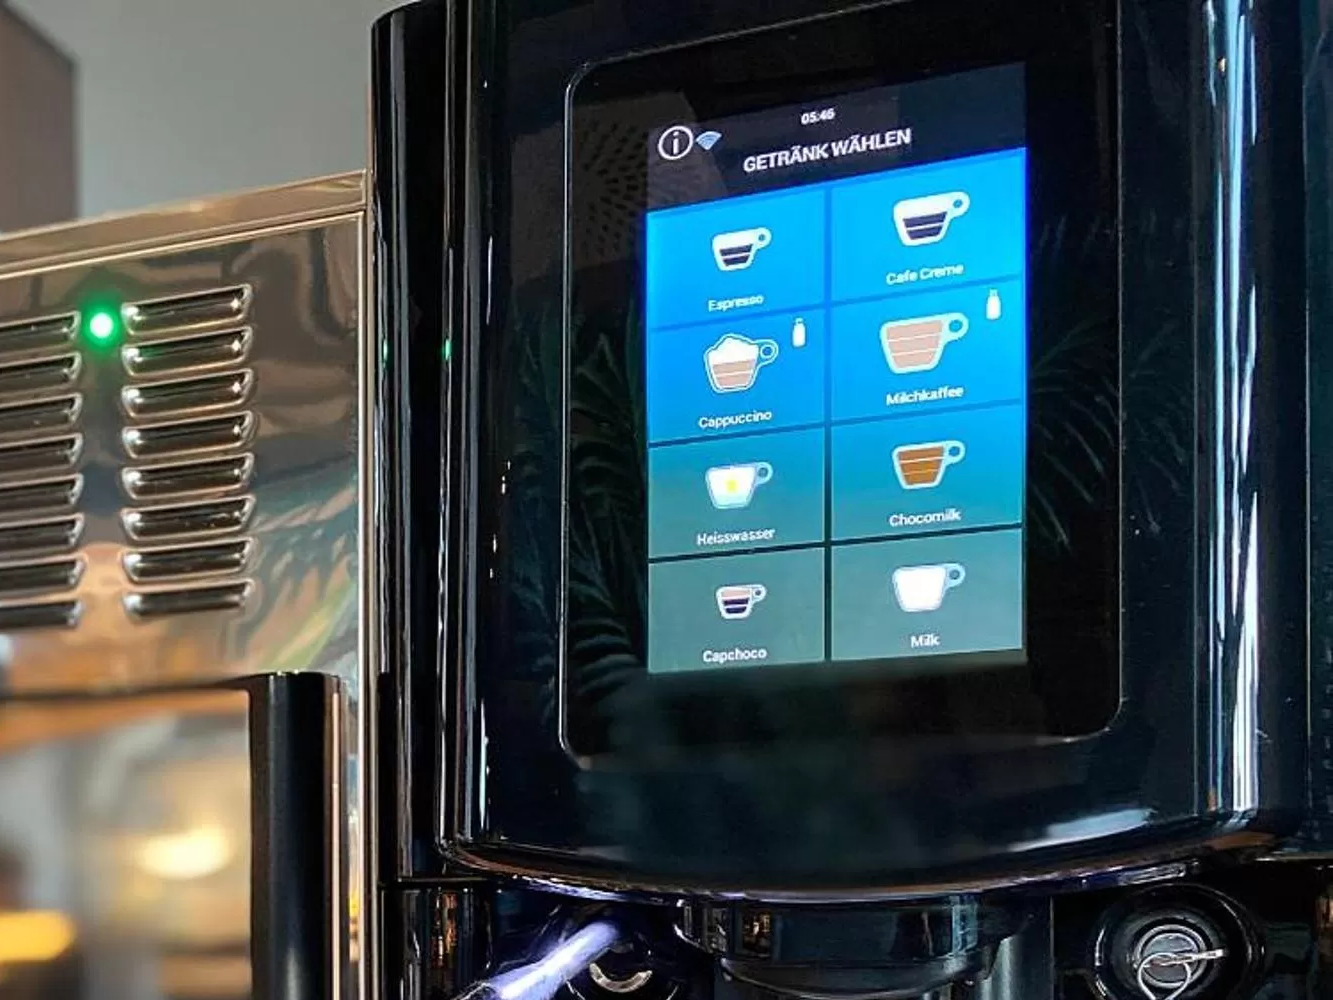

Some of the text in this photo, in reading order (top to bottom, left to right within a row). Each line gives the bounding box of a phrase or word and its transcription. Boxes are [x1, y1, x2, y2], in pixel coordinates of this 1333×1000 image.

[743, 128, 912, 173] GETRÄNK WÄHLEN
[885, 263, 964, 286] Cafe Creme
[708, 293, 764, 312] Espresso
[885, 385, 964, 407] Milchkaffee
[698, 409, 772, 430] Cappuccino
[889, 508, 962, 528] Chocomilk
[697, 526, 776, 547] Heisswasser
[910, 634, 939, 649] Milk
[703, 647, 767, 664] Capchoco
